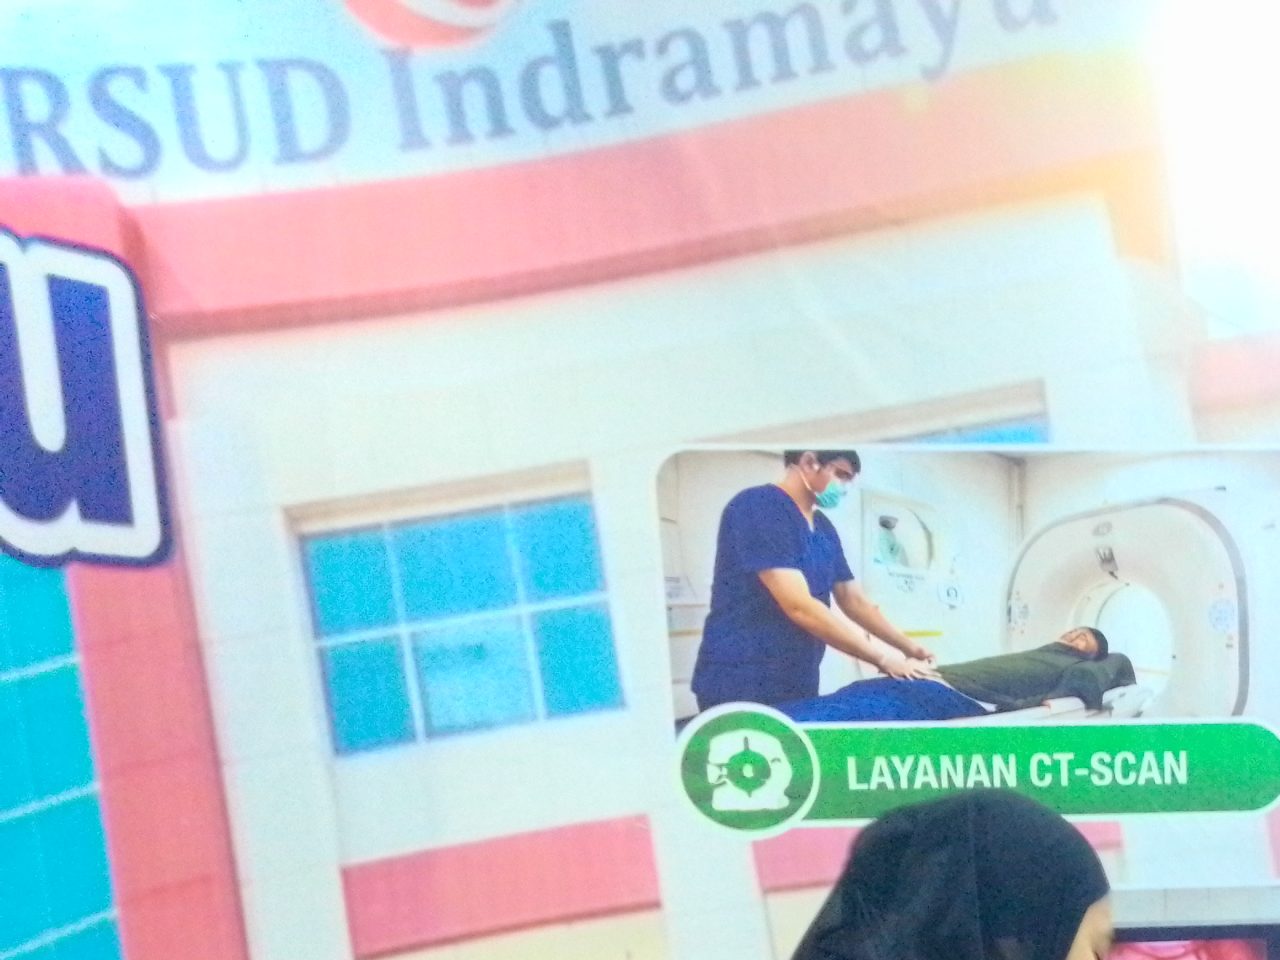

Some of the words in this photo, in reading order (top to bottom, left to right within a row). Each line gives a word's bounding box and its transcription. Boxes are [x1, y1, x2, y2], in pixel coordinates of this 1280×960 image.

[0, 57, 353, 178] RSUD
[847, 752, 1018, 791] LAYANAN
[1029, 750, 1189, 787] CT-SCAN
